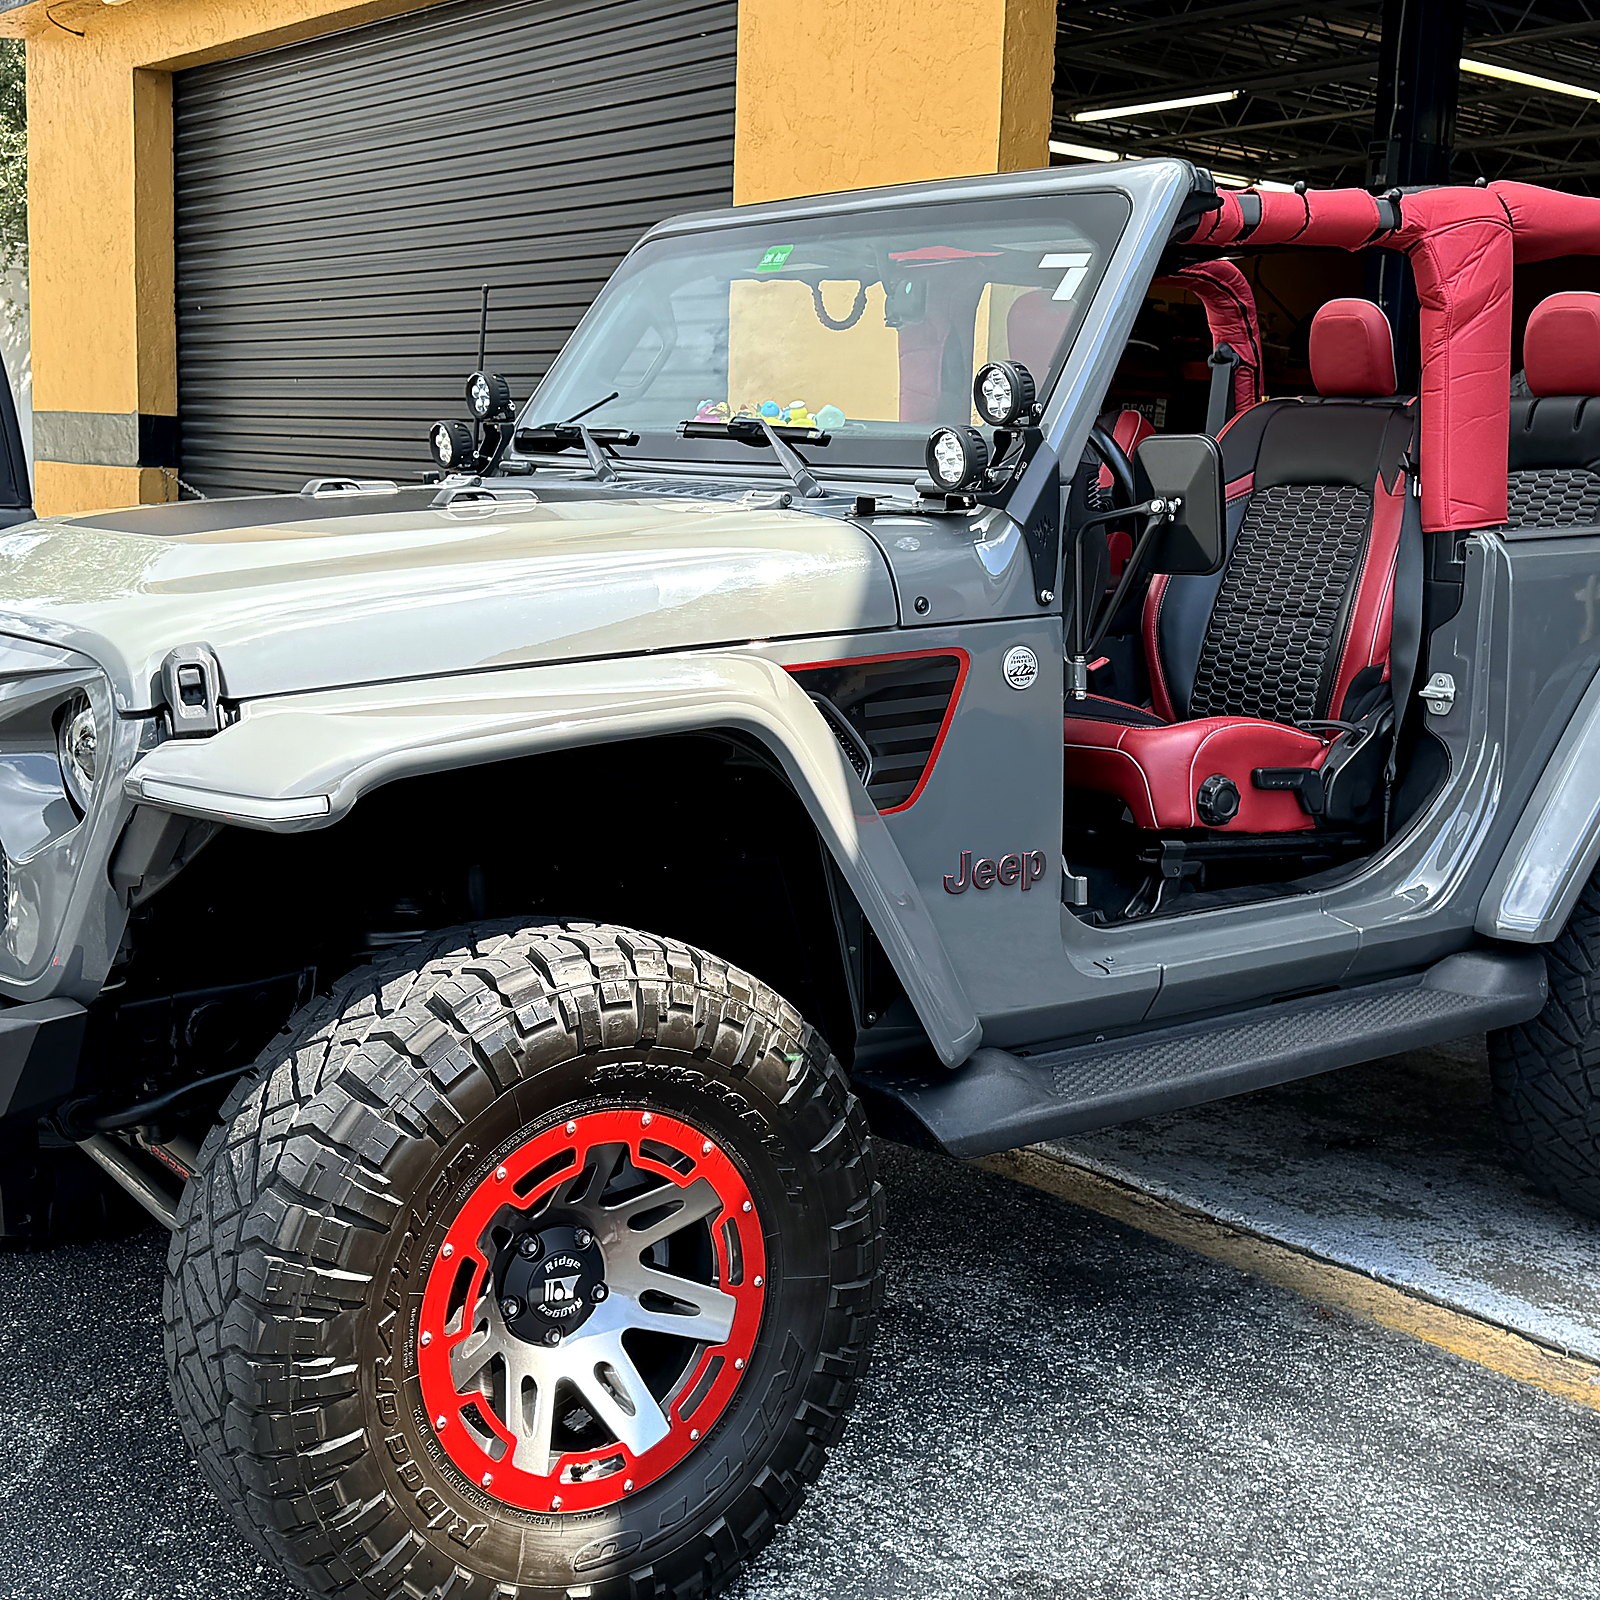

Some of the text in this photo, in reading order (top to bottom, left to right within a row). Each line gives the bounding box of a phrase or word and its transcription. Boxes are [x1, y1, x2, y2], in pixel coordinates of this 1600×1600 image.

[943, 849, 1047, 895] Jeep
[544, 1255, 581, 1274] Ridge
[537, 1297, 583, 1318] Rugged
